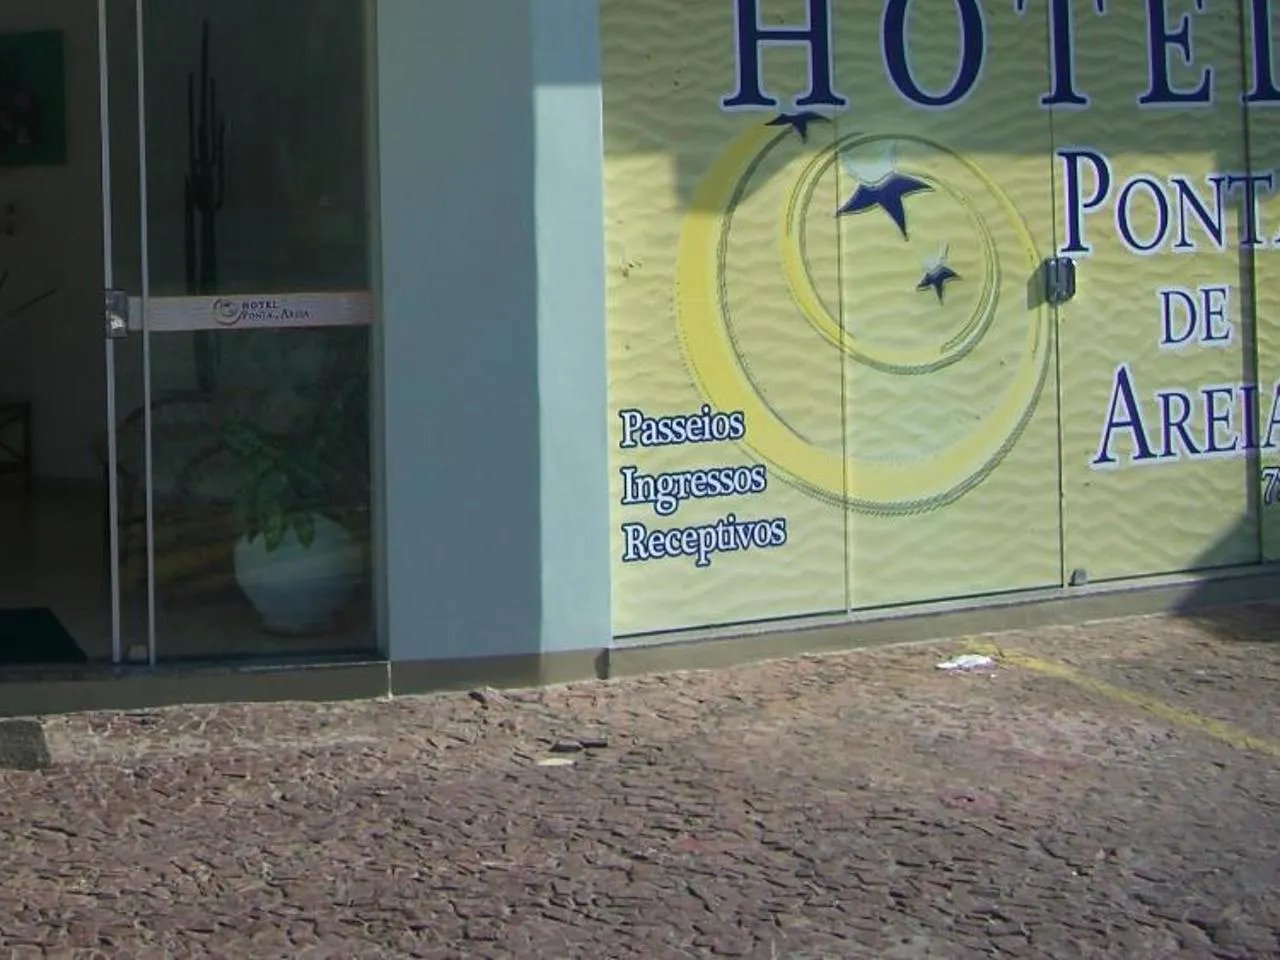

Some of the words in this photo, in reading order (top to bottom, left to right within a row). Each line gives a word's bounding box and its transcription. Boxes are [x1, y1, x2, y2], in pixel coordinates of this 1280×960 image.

[1056, 150, 1280, 253] PONT
[1161, 287, 1230, 344] DE
[620, 403, 746, 448] Passeios
[620, 464, 767, 515] Ingressos
[622, 512, 787, 567] Receptivos
